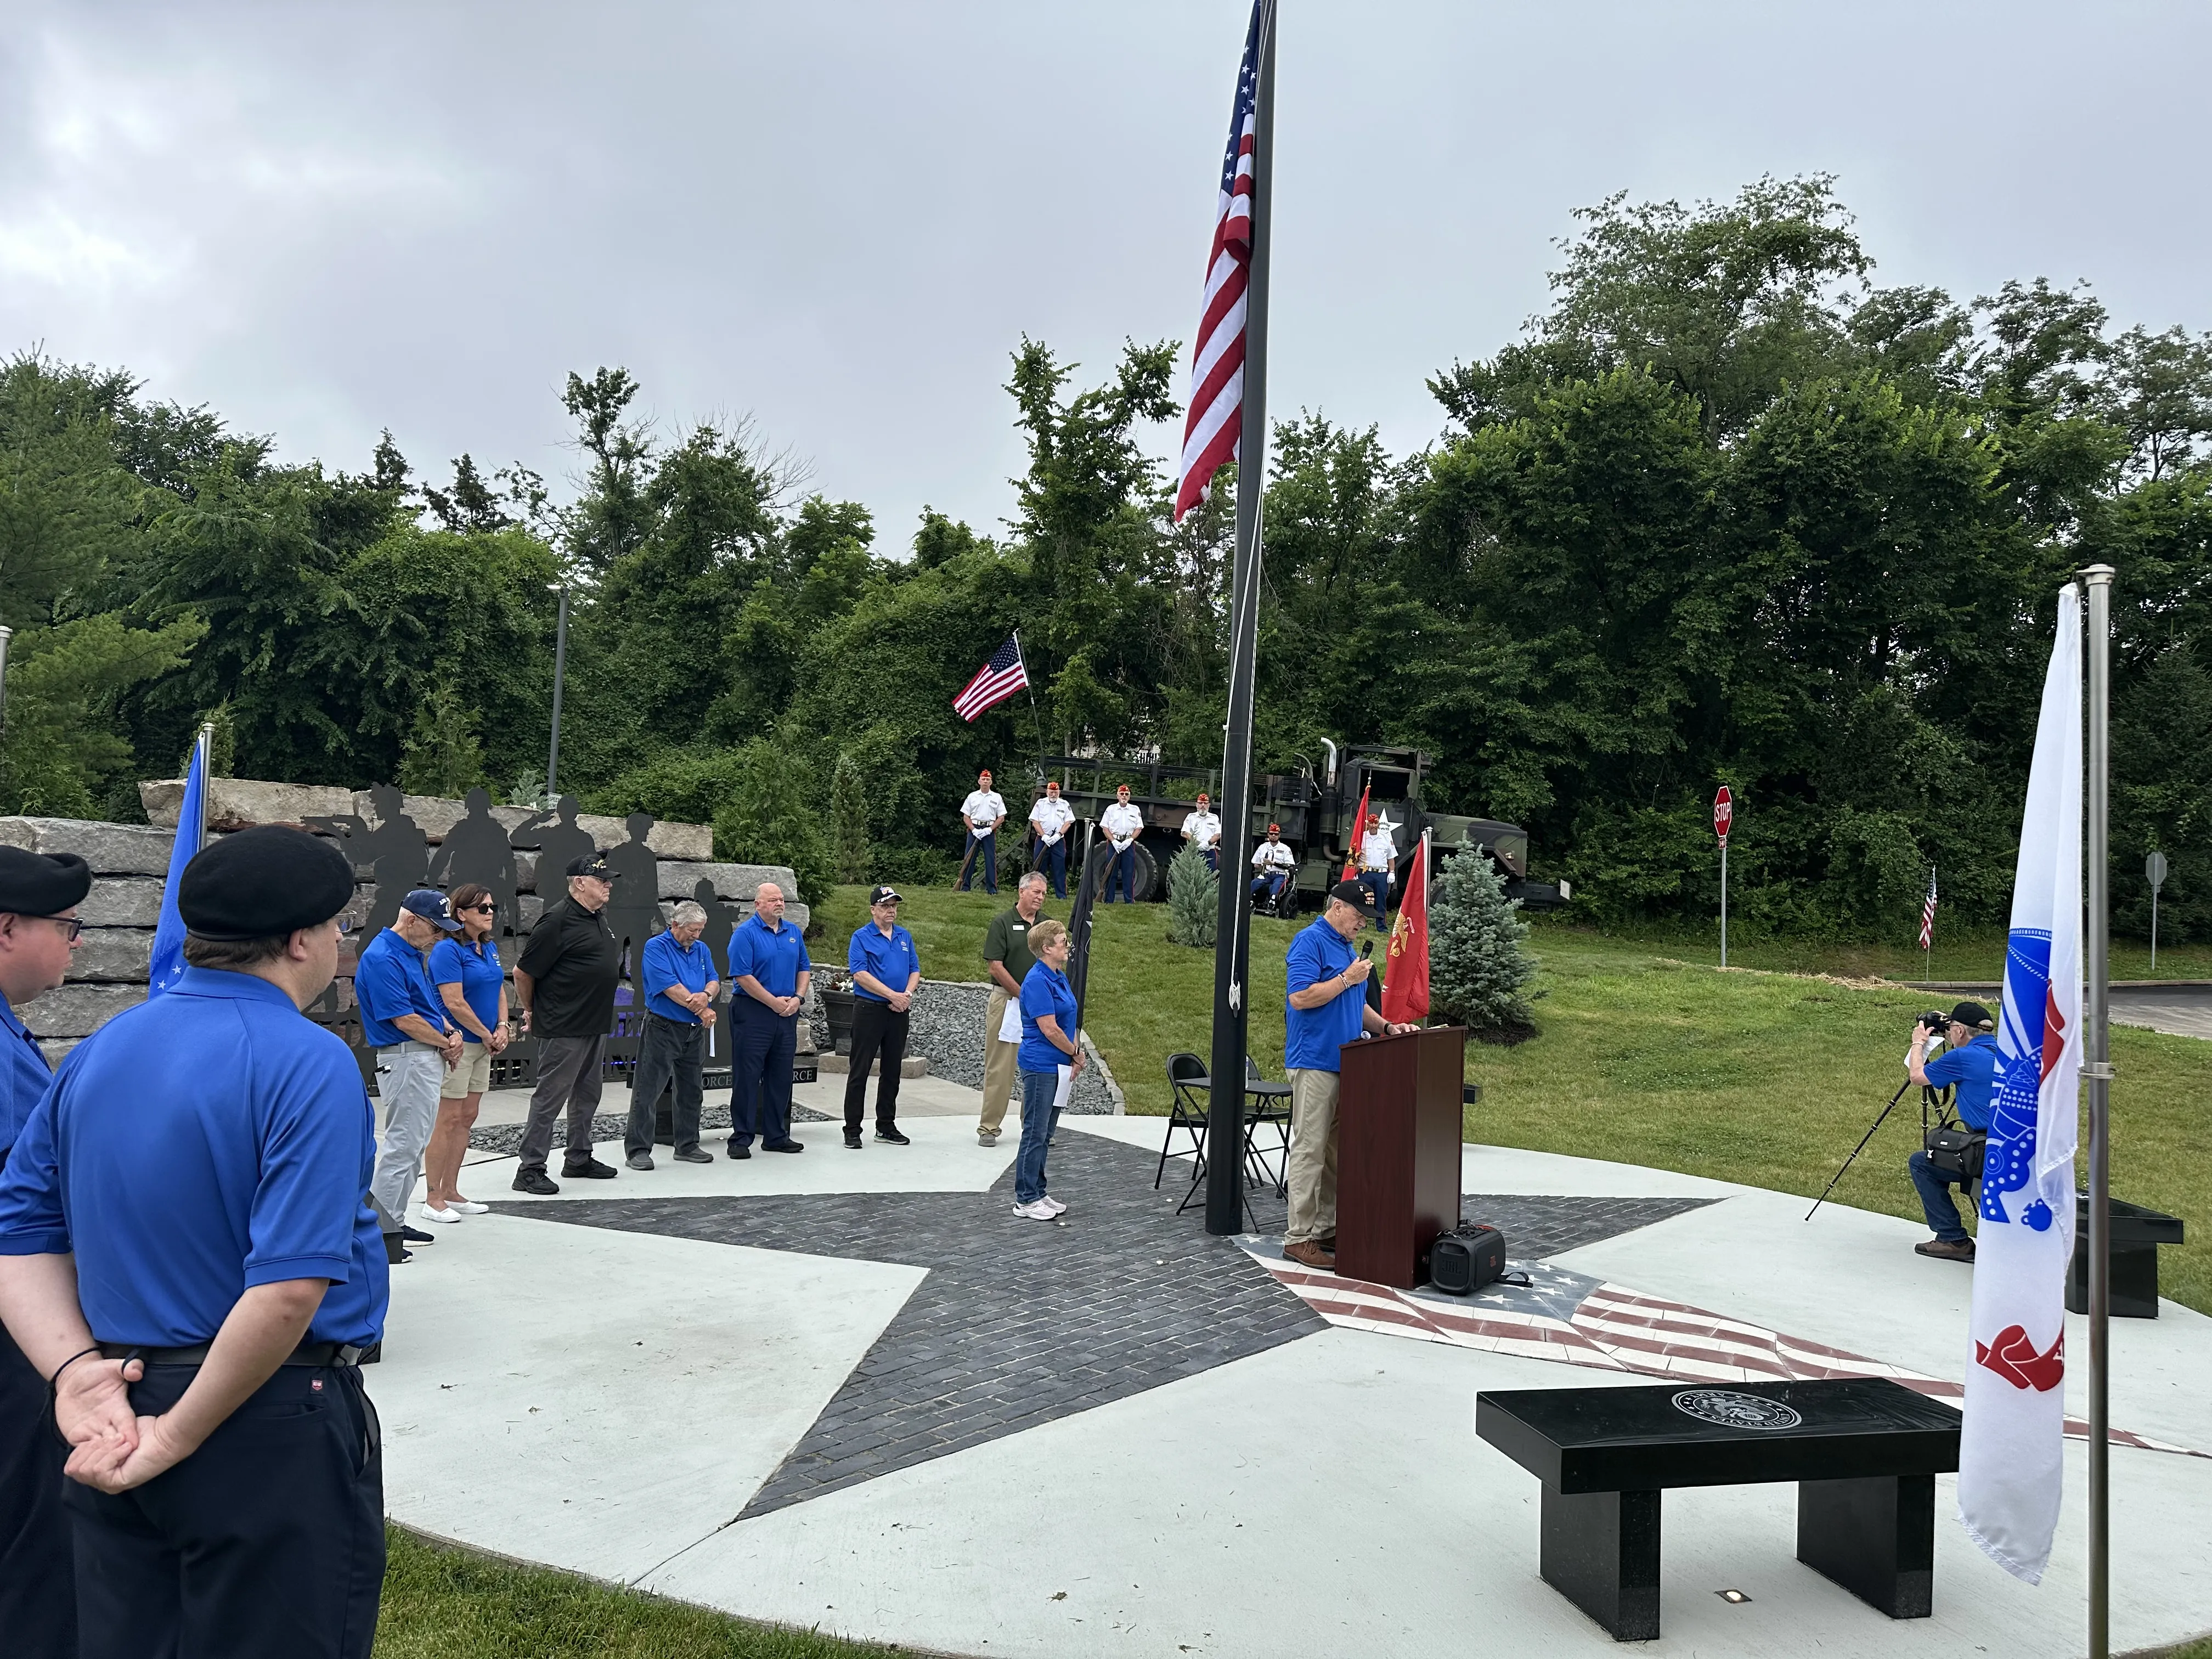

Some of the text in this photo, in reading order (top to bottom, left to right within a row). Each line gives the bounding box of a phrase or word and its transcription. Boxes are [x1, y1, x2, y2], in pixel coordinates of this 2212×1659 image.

[1716, 802, 1730, 822] STOP
[701, 1070, 812, 1087] ORCE RCE
[1442, 1259, 1462, 1274] JBL
[1710, 1414, 1763, 1427] STATES
